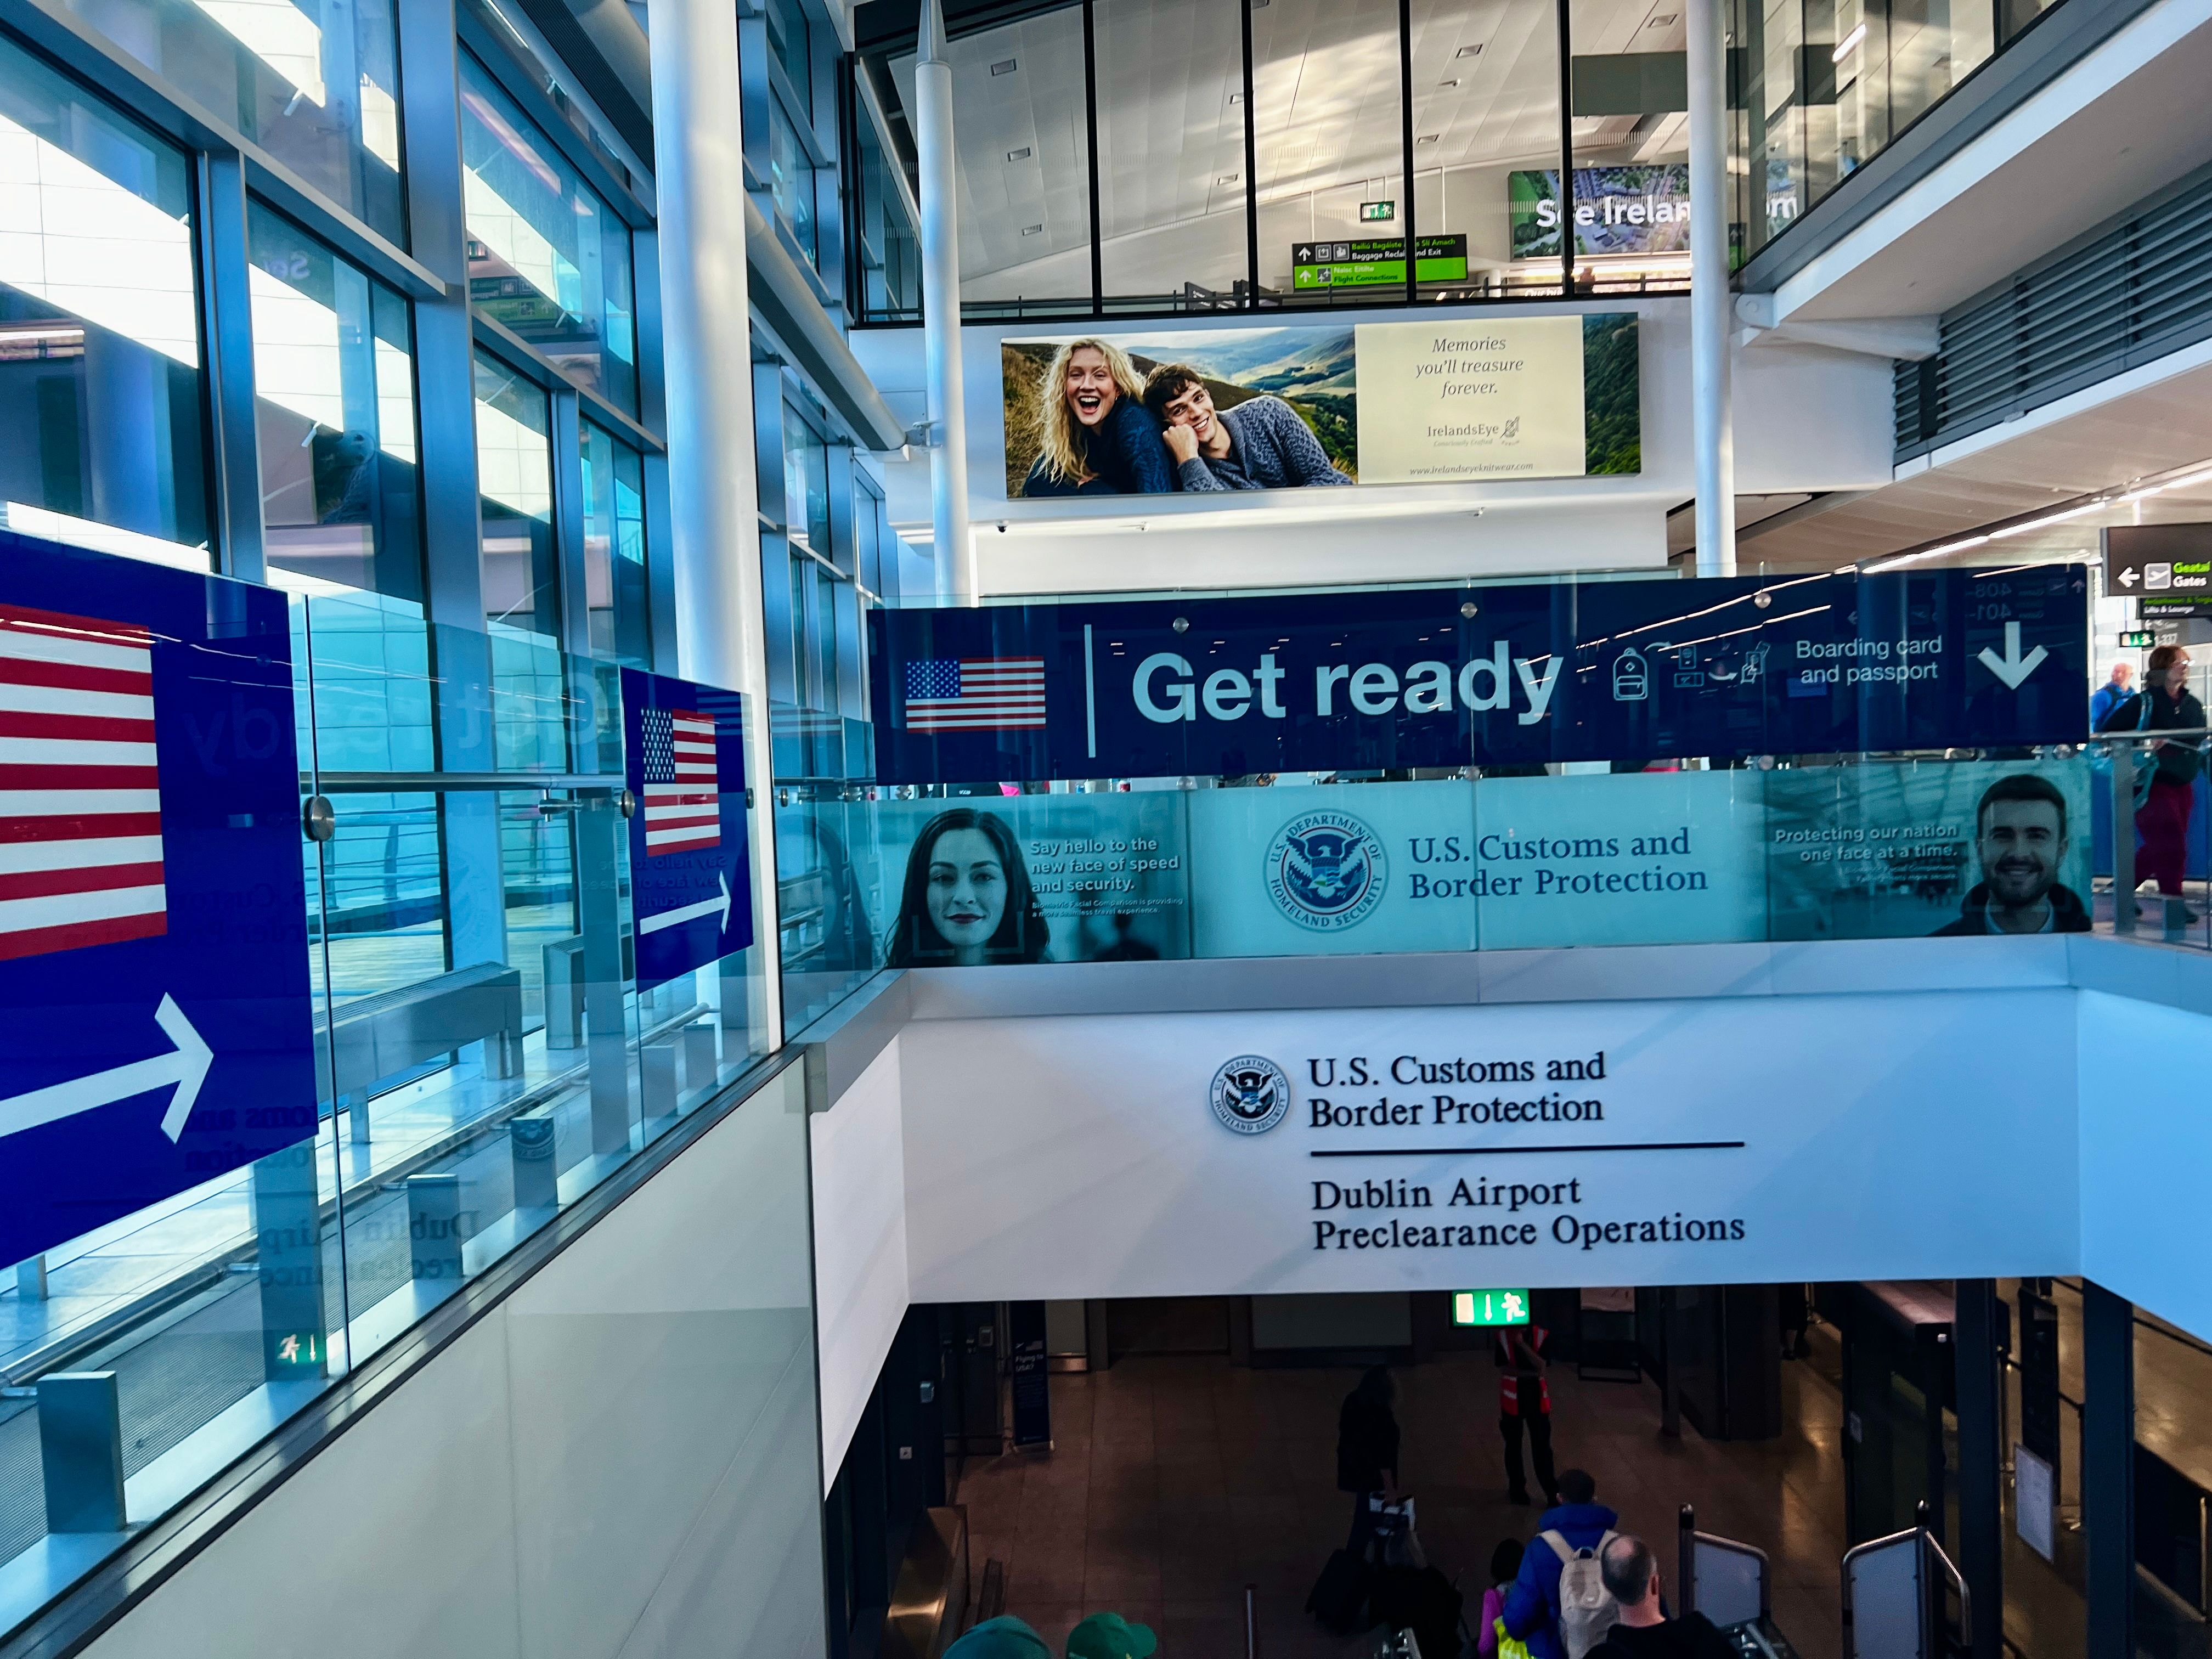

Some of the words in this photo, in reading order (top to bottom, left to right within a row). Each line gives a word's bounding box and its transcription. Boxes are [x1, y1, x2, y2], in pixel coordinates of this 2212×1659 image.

[1605, 194, 1690, 225] Irelan
[1352, 252, 1383, 261] Baggage
[1416, 249, 1426, 257] nd
[1428, 248, 1441, 256] Exit
[1334, 275, 1353, 284] Flight
[1432, 336, 1506, 353] Memories
[1416, 359, 1457, 379] you'll
[1461, 359, 1523, 374] treasure
[1441, 381, 1498, 399] forever.
[1427, 424, 1499, 437] IrelandsEye
[2173, 575, 2207, 588] Gates
[1796, 638, 1889, 660] Boarding
[1897, 635, 1942, 654] card
[1133, 652, 1286, 724] Get
[1316, 640, 1564, 726] ready
[1801, 664, 1839, 684] and
[1847, 661, 1938, 686] passport
[1287, 814, 1373, 843] DEPARTMENT
[1368, 843, 1383, 861] OF
[1775, 826, 1864, 843] Protecting
[1869, 827, 1899, 839] our
[1903, 824, 1957, 838] nation
[1031, 841, 1059, 856] Say
[1064, 839, 1104, 853] hello
[1110, 839, 1126, 852] to
[1131, 837, 1158, 850] the
[1408, 837, 1470, 864] U.S.
[1479, 834, 1620, 861] Customs
[1630, 827, 1691, 856] and
[1800, 849, 1831, 862] one
[1837, 846, 1872, 860] face
[1876, 845, 1894, 859] at
[1899, 848, 1910, 857] a
[1915, 844, 1957, 857] time.
[1032, 862, 1064, 874] new
[1069, 860, 1103, 872] face
[1108, 858, 1125, 871] of
[1129, 855, 1180, 872] speed
[1032, 879, 1062, 892] and
[1067, 878, 1135, 892] security.
[1409, 870, 1522, 899] Border
[1535, 865, 1708, 895] Protection
[1271, 878, 1330, 927] HOMELAND
[1335, 874, 1383, 926] SECURITY
[1307, 1058, 1379, 1087] U.S.
[1391, 1056, 1535, 1086] Customs
[1547, 1051, 1606, 1081] and
[1308, 1098, 1423, 1128] Border
[1432, 1092, 1604, 1125] Protection
[1311, 1178, 1431, 1210] Dublin
[1448, 1176, 1582, 1212] Airport
[1313, 1219, 1537, 1250] Preclearance
[1551, 1212, 1745, 1251] Operations
